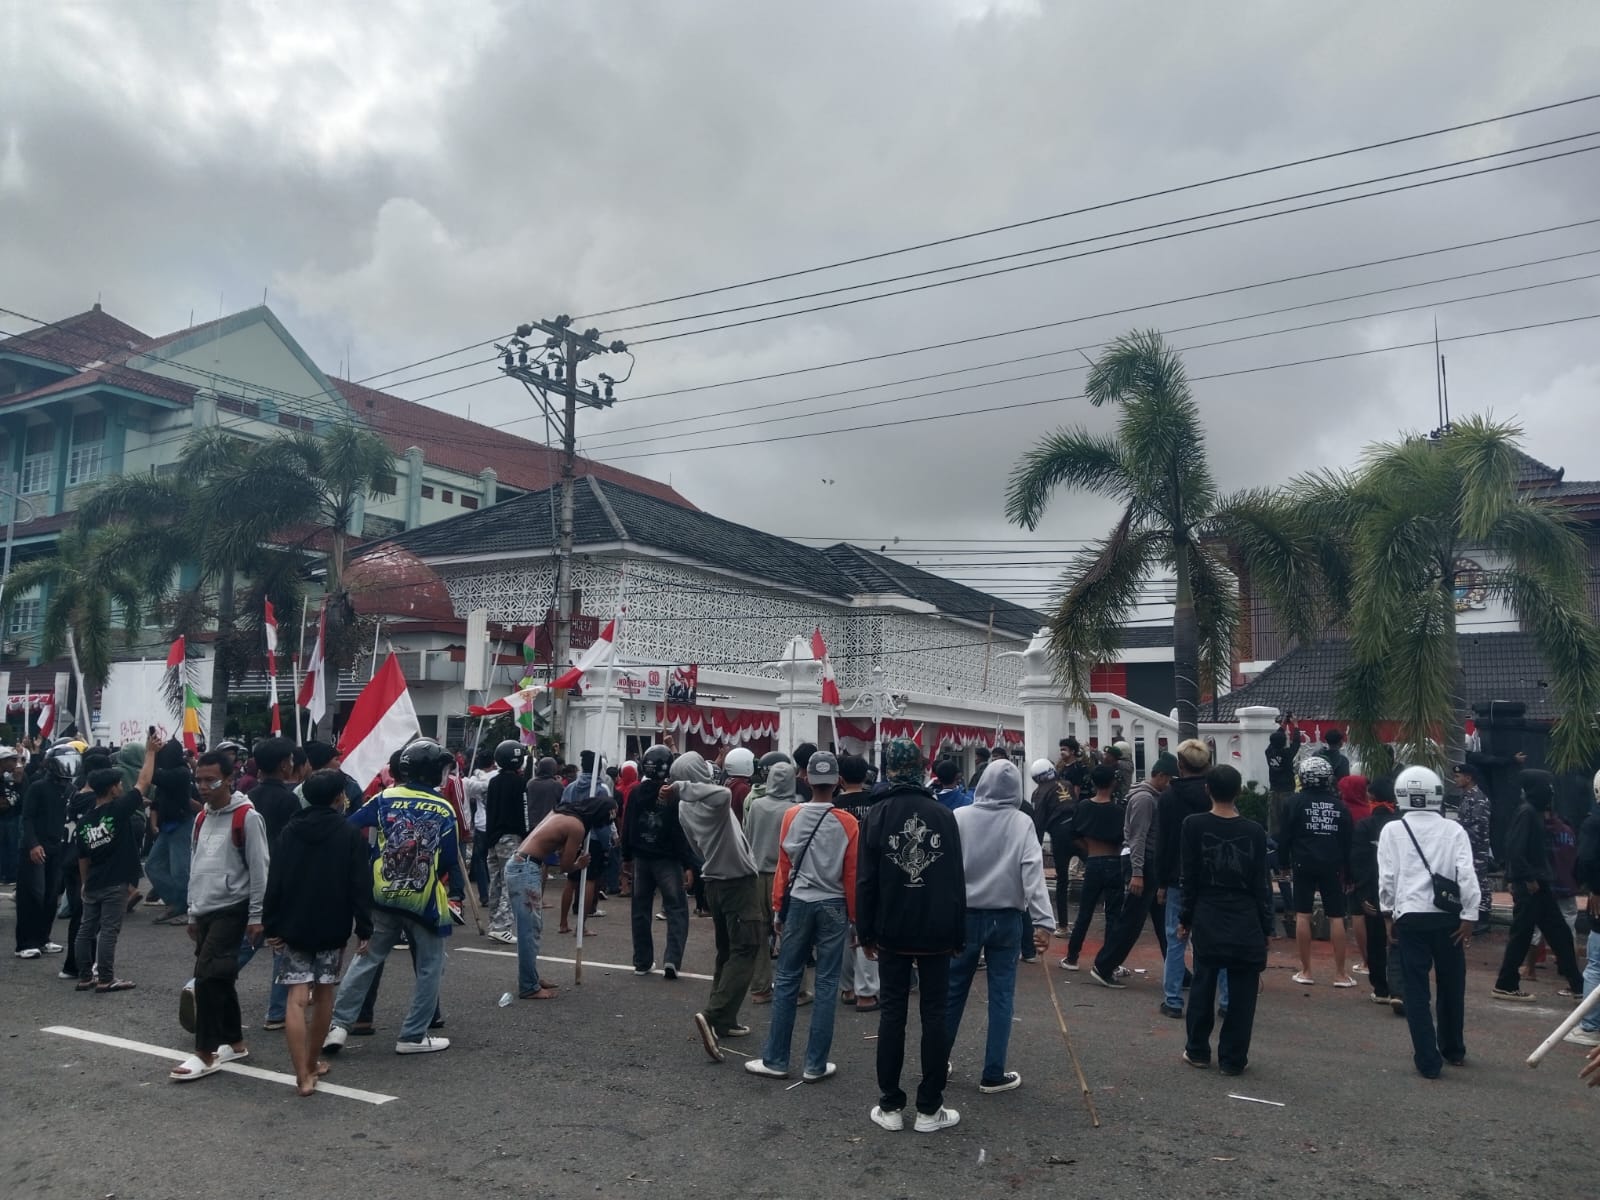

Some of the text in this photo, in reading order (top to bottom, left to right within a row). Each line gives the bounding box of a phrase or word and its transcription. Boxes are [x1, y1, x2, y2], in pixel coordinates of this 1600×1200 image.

[414, 801, 451, 818] KING
[1311, 801, 1335, 810] CLOSE
[1304, 808, 1341, 818] THE EYES
[1311, 816, 1334, 824] ENJOY
[1305, 822, 1339, 831] THE MIND
